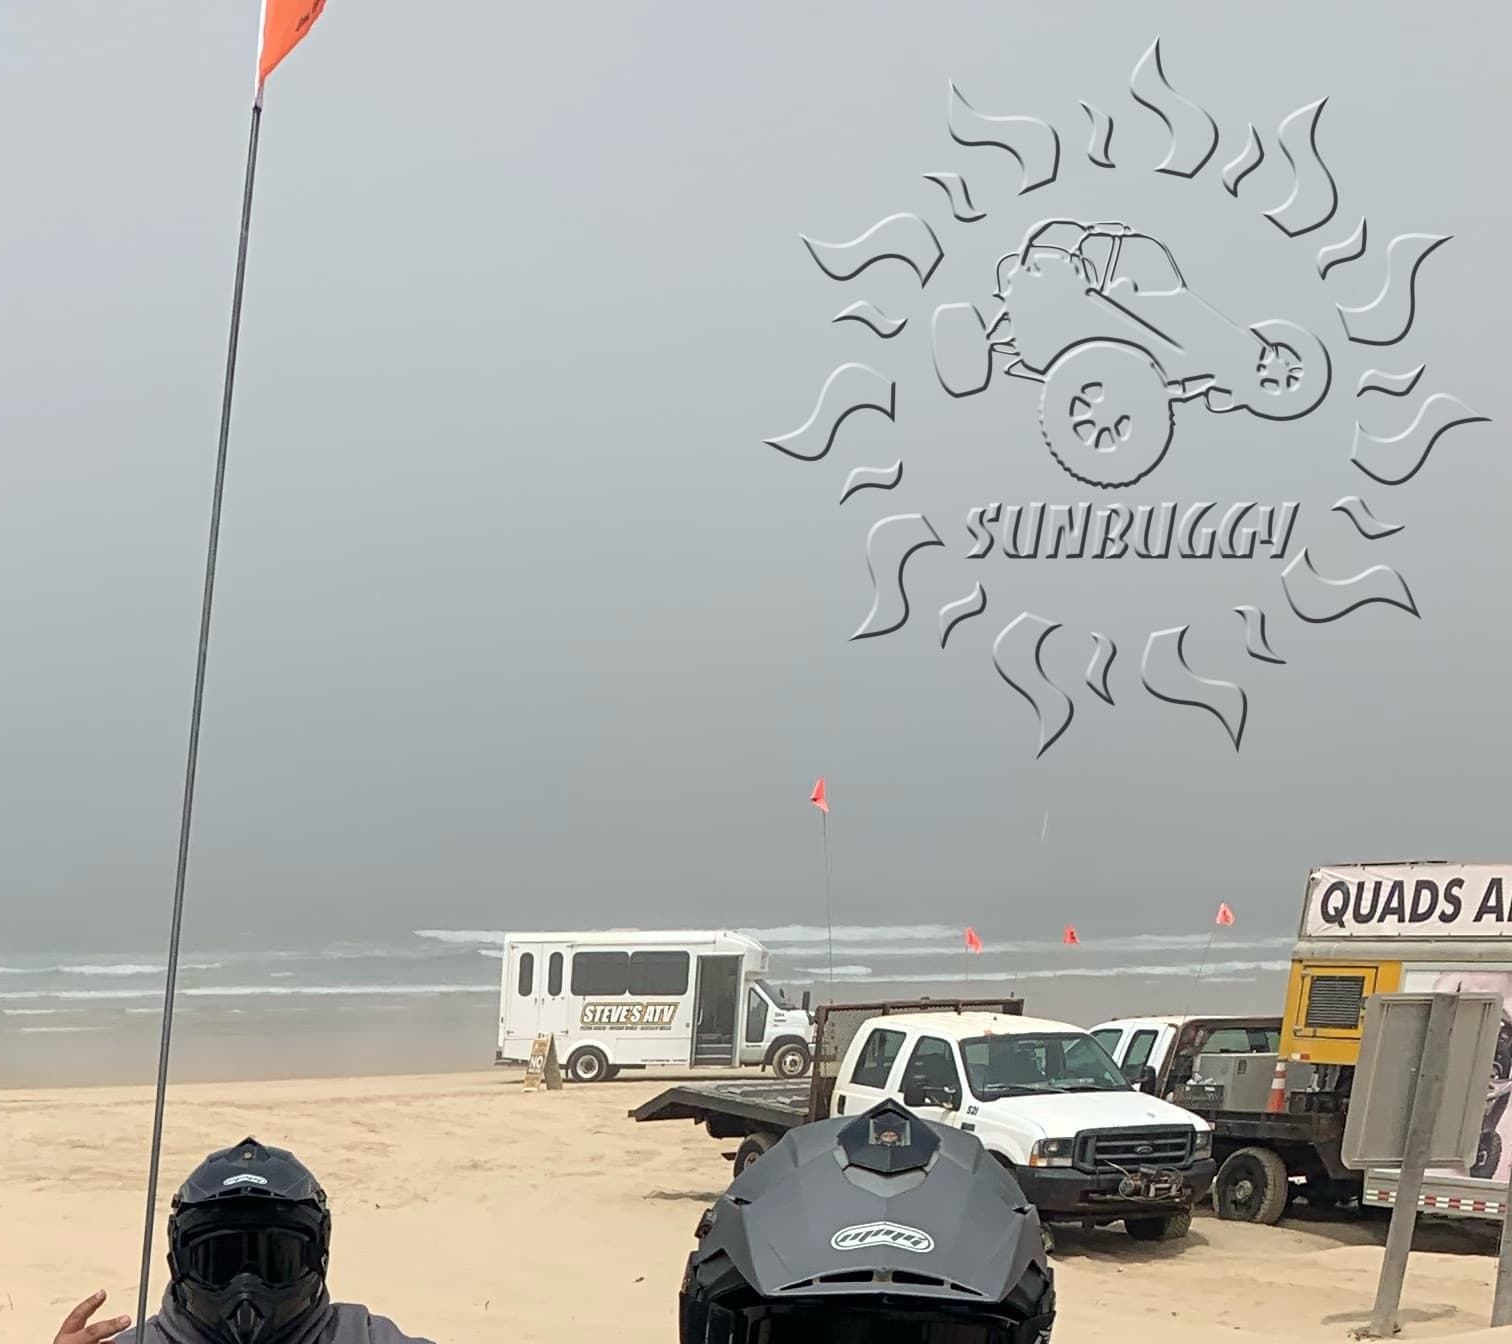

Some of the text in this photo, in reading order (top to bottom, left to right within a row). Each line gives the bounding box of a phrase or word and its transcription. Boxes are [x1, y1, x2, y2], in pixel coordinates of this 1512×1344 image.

[1320, 877, 1512, 928] QUADS A
[582, 1005, 677, 1024] STEVE'S ATV
